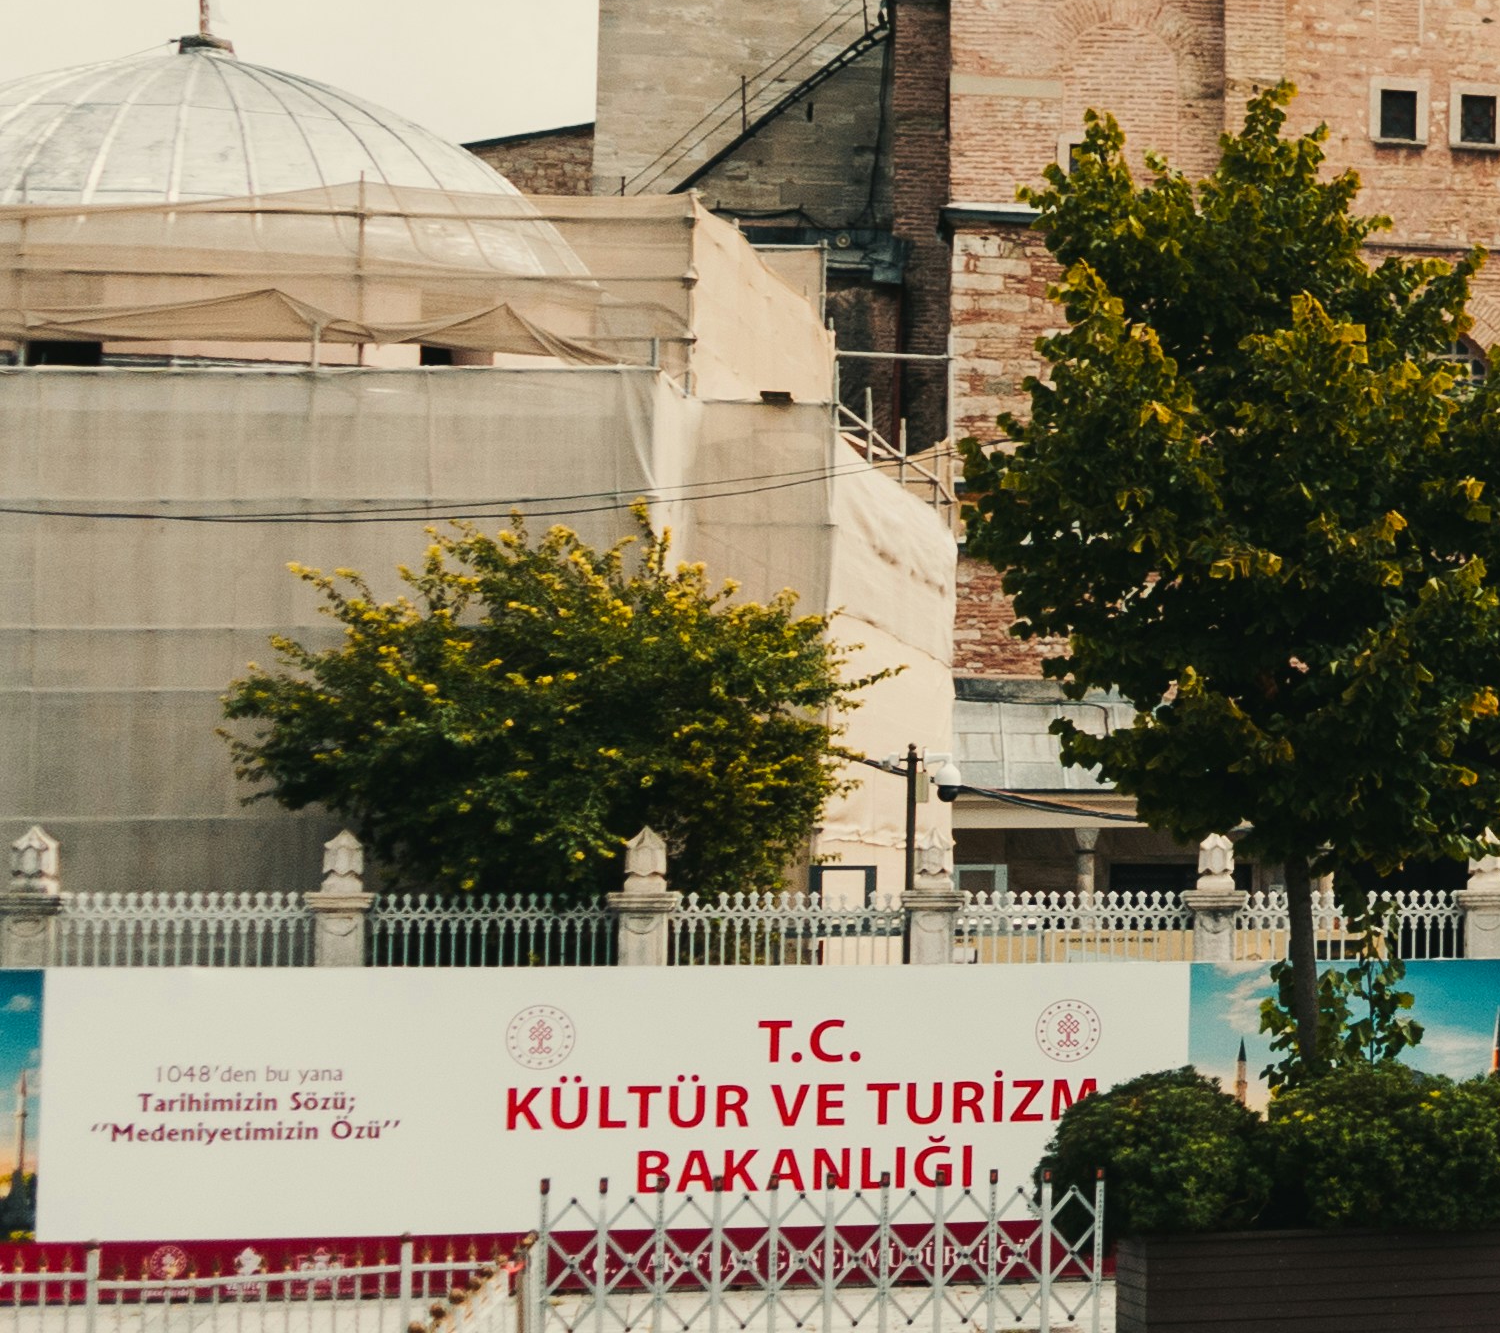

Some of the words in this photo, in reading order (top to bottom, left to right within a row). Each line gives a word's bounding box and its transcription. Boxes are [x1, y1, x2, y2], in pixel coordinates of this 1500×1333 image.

[757, 1019, 862, 1064] T.C.
[155, 1064, 257, 1084] 1048'den
[265, 1064, 289, 1083] bu
[297, 1067, 344, 1085] yana
[138, 1092, 278, 1113] Tarihimizin
[290, 1091, 356, 1114] Sözü;
[505, 1075, 750, 1131] KÜLTÜR
[770, 1083, 845, 1127] VE
[866, 1070, 1098, 1126] TURİZM
[636, 1135, 973, 1194] BAKANLIĞI
